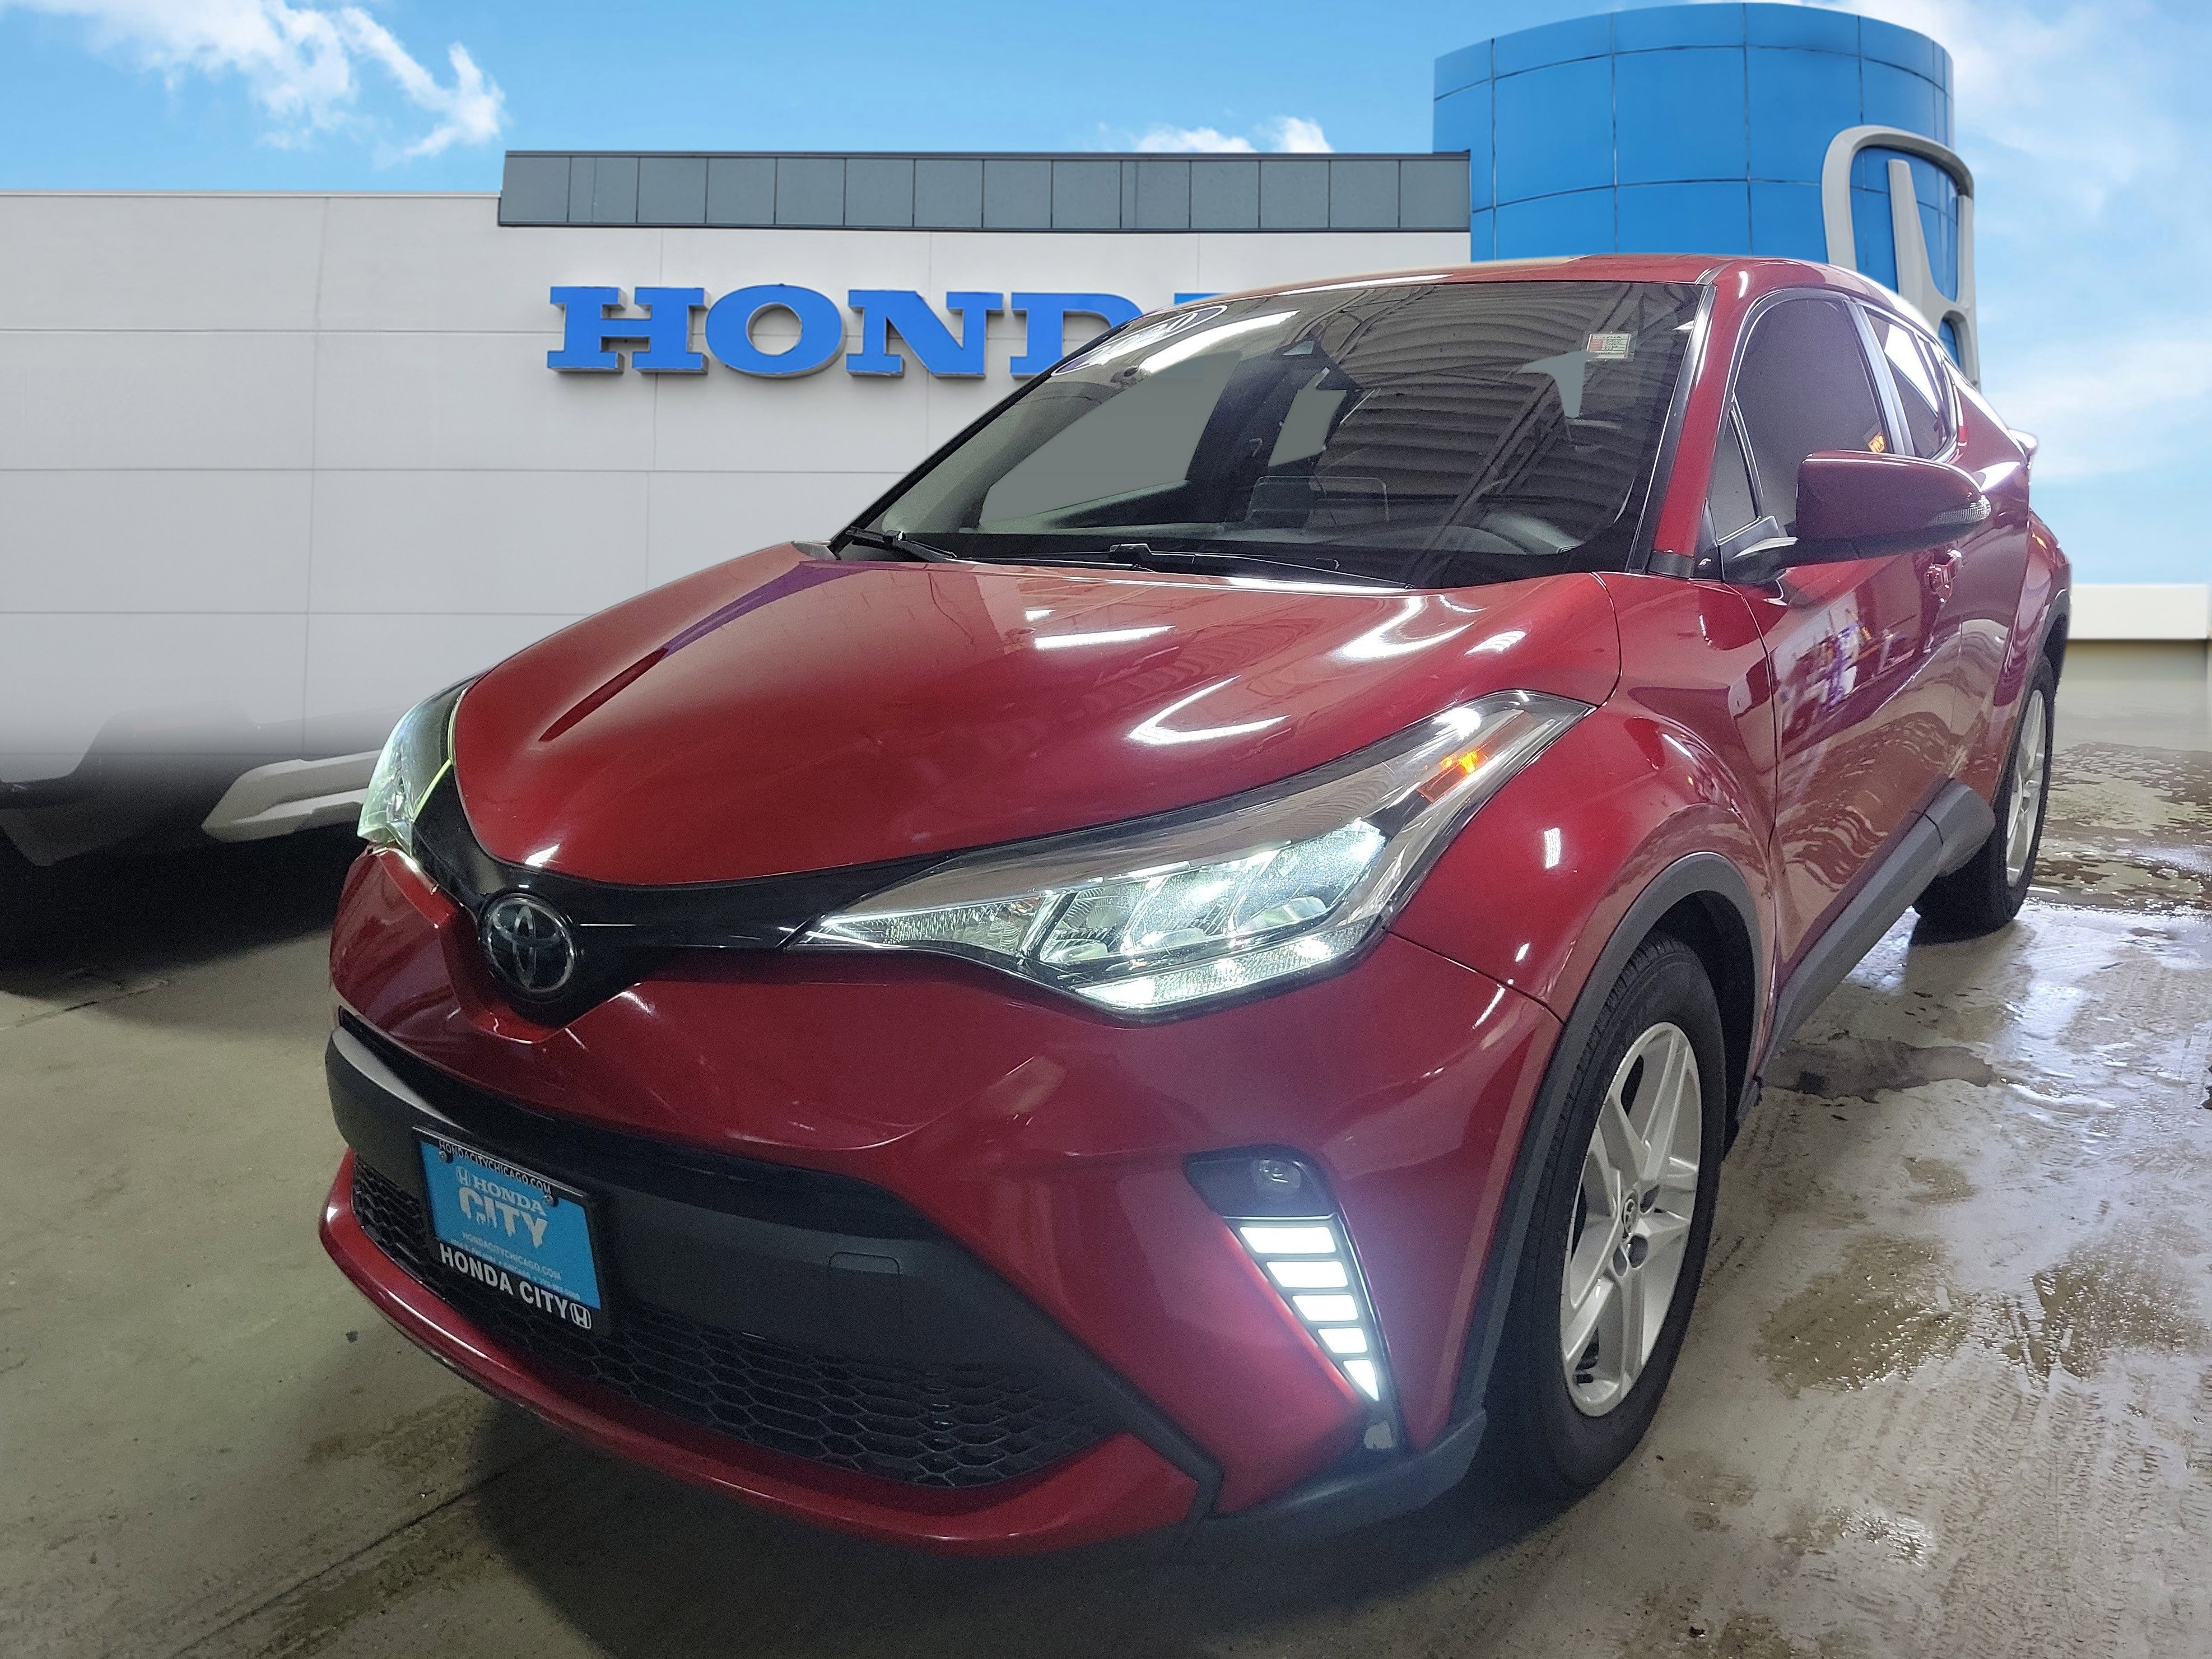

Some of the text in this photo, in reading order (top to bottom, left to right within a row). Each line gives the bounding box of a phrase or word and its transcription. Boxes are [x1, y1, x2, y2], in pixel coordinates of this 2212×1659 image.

[547, 284, 1228, 377] HOND
[439, 1139, 552, 1195] HONDACITYCHICAGO.COM
[472, 1174, 547, 1216] HONDA
[459, 1186, 548, 1249] CITY
[439, 1243, 514, 1296] HONDA
[519, 1280, 568, 1319] CITY
